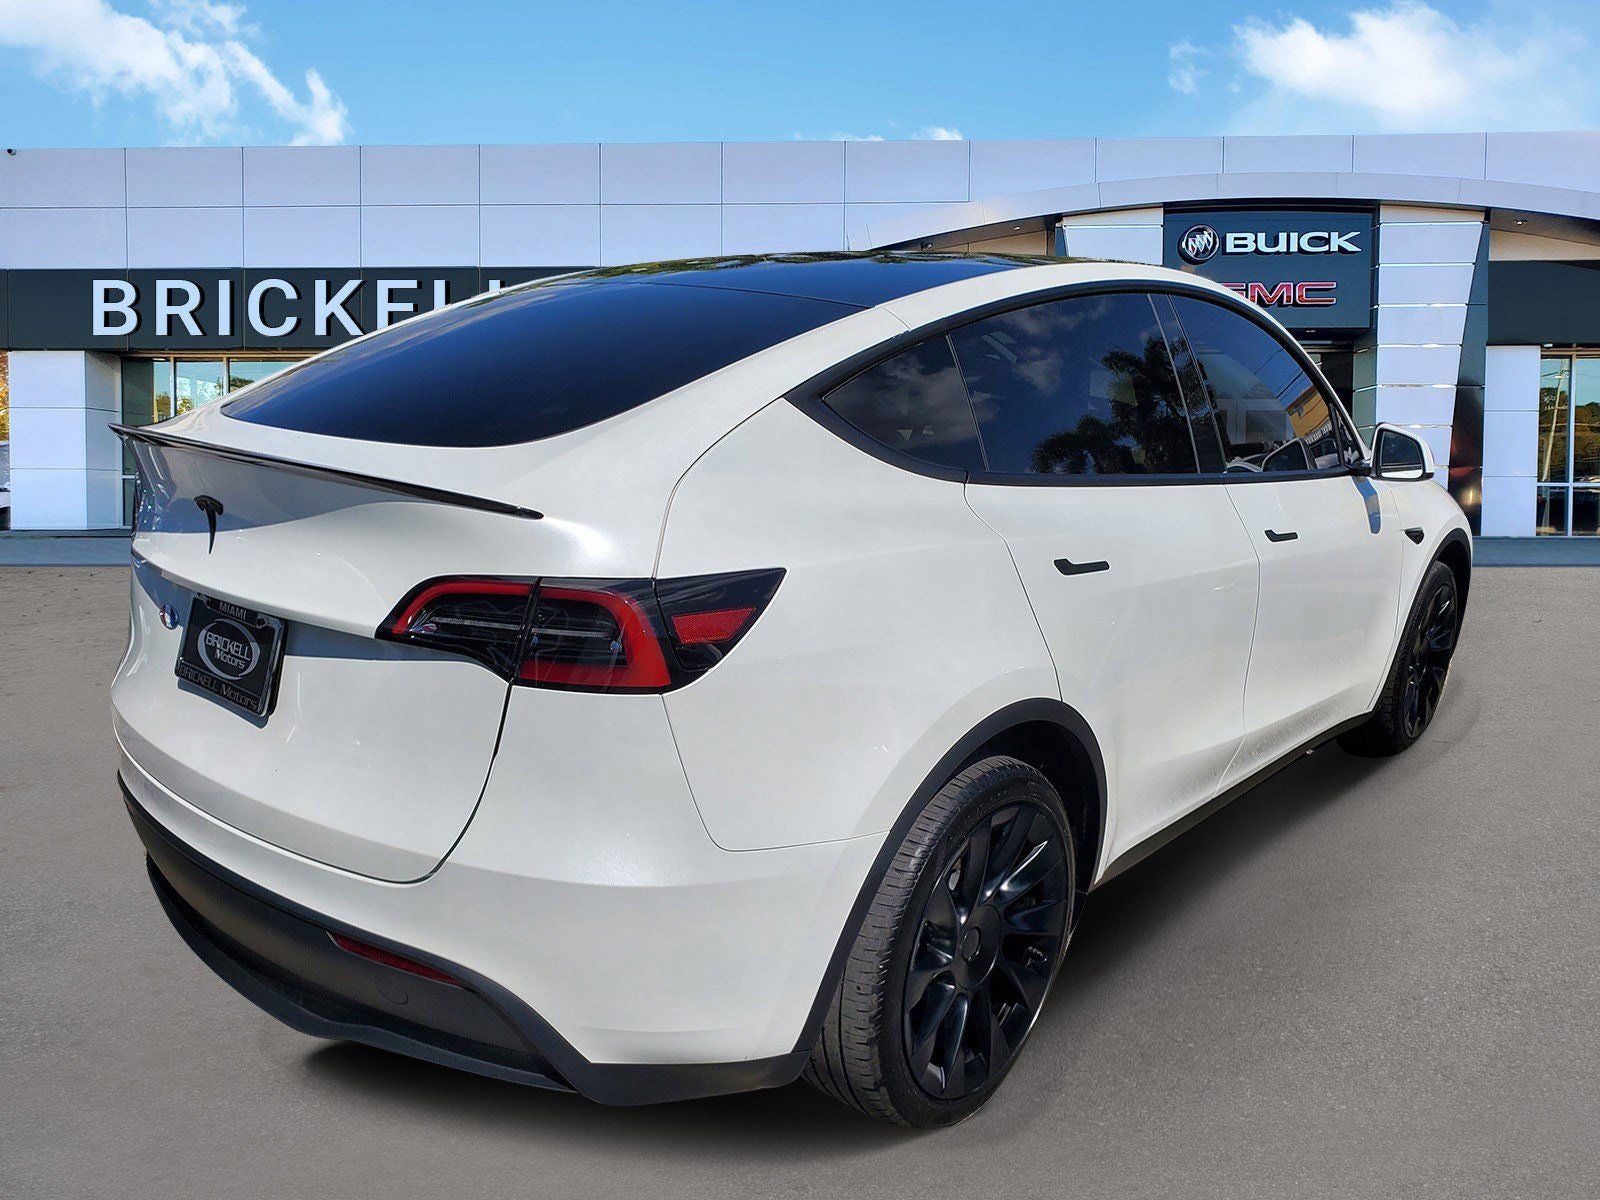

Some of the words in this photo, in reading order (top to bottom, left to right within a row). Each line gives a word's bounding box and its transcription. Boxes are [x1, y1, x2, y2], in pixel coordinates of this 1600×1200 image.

[1226, 231, 1361, 253] BUICK
[92, 278, 501, 337] BRICKE
[219, 601, 247, 620] MIAMI
[206, 632, 251, 661] BRICKELL
[214, 648, 246, 670] Motors
[179, 665, 219, 691] BRICKELL
[220, 683, 258, 710] Motors
